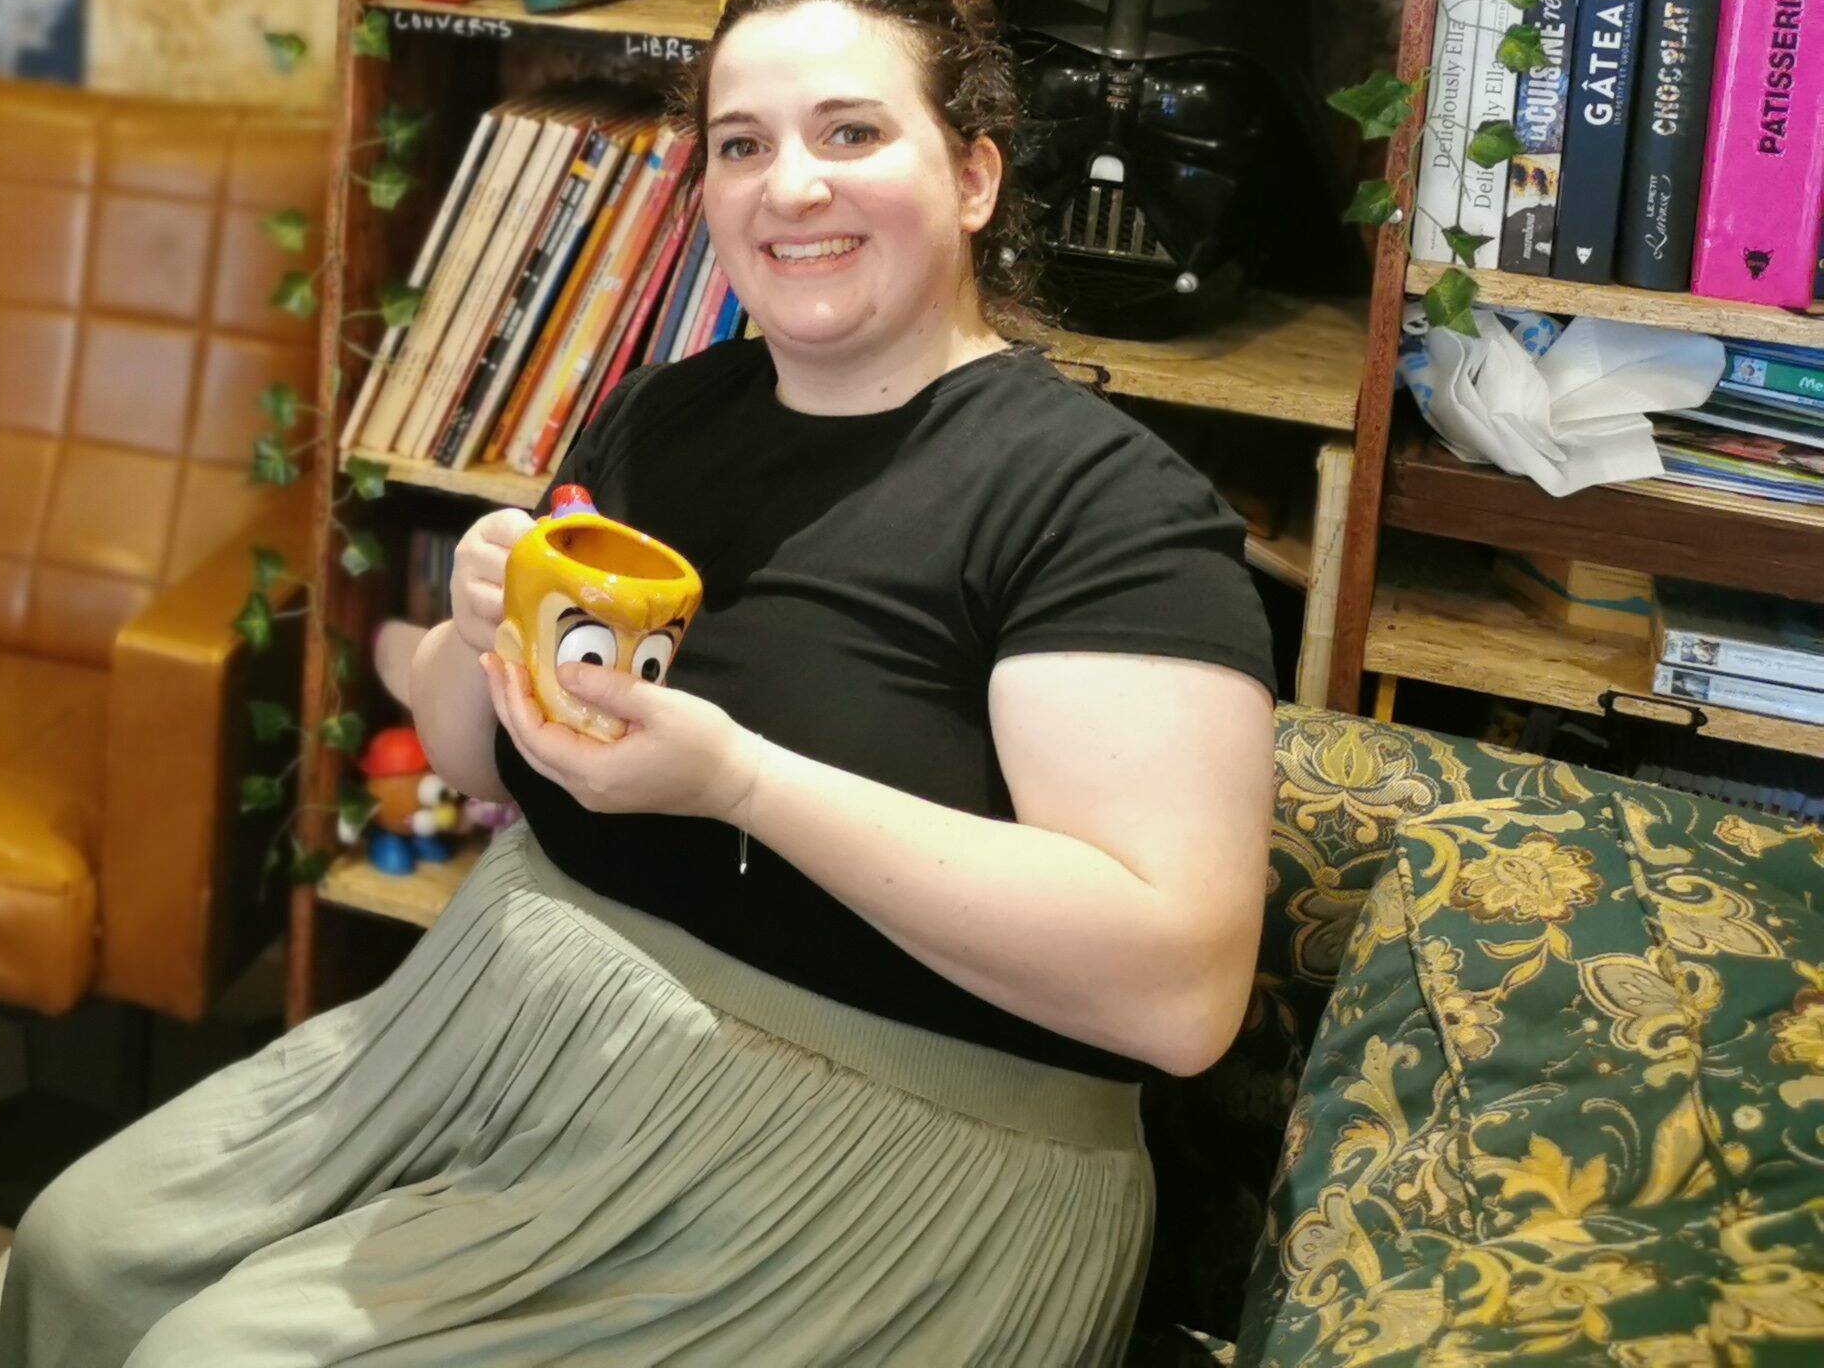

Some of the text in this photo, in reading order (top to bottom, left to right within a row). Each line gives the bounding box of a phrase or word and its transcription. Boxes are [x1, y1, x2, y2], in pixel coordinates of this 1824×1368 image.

[394, 12, 512, 37] COUVERTS
[1445, 20, 1467, 57] Ella
[1651, 2, 1690, 135] CHOCOLAT
